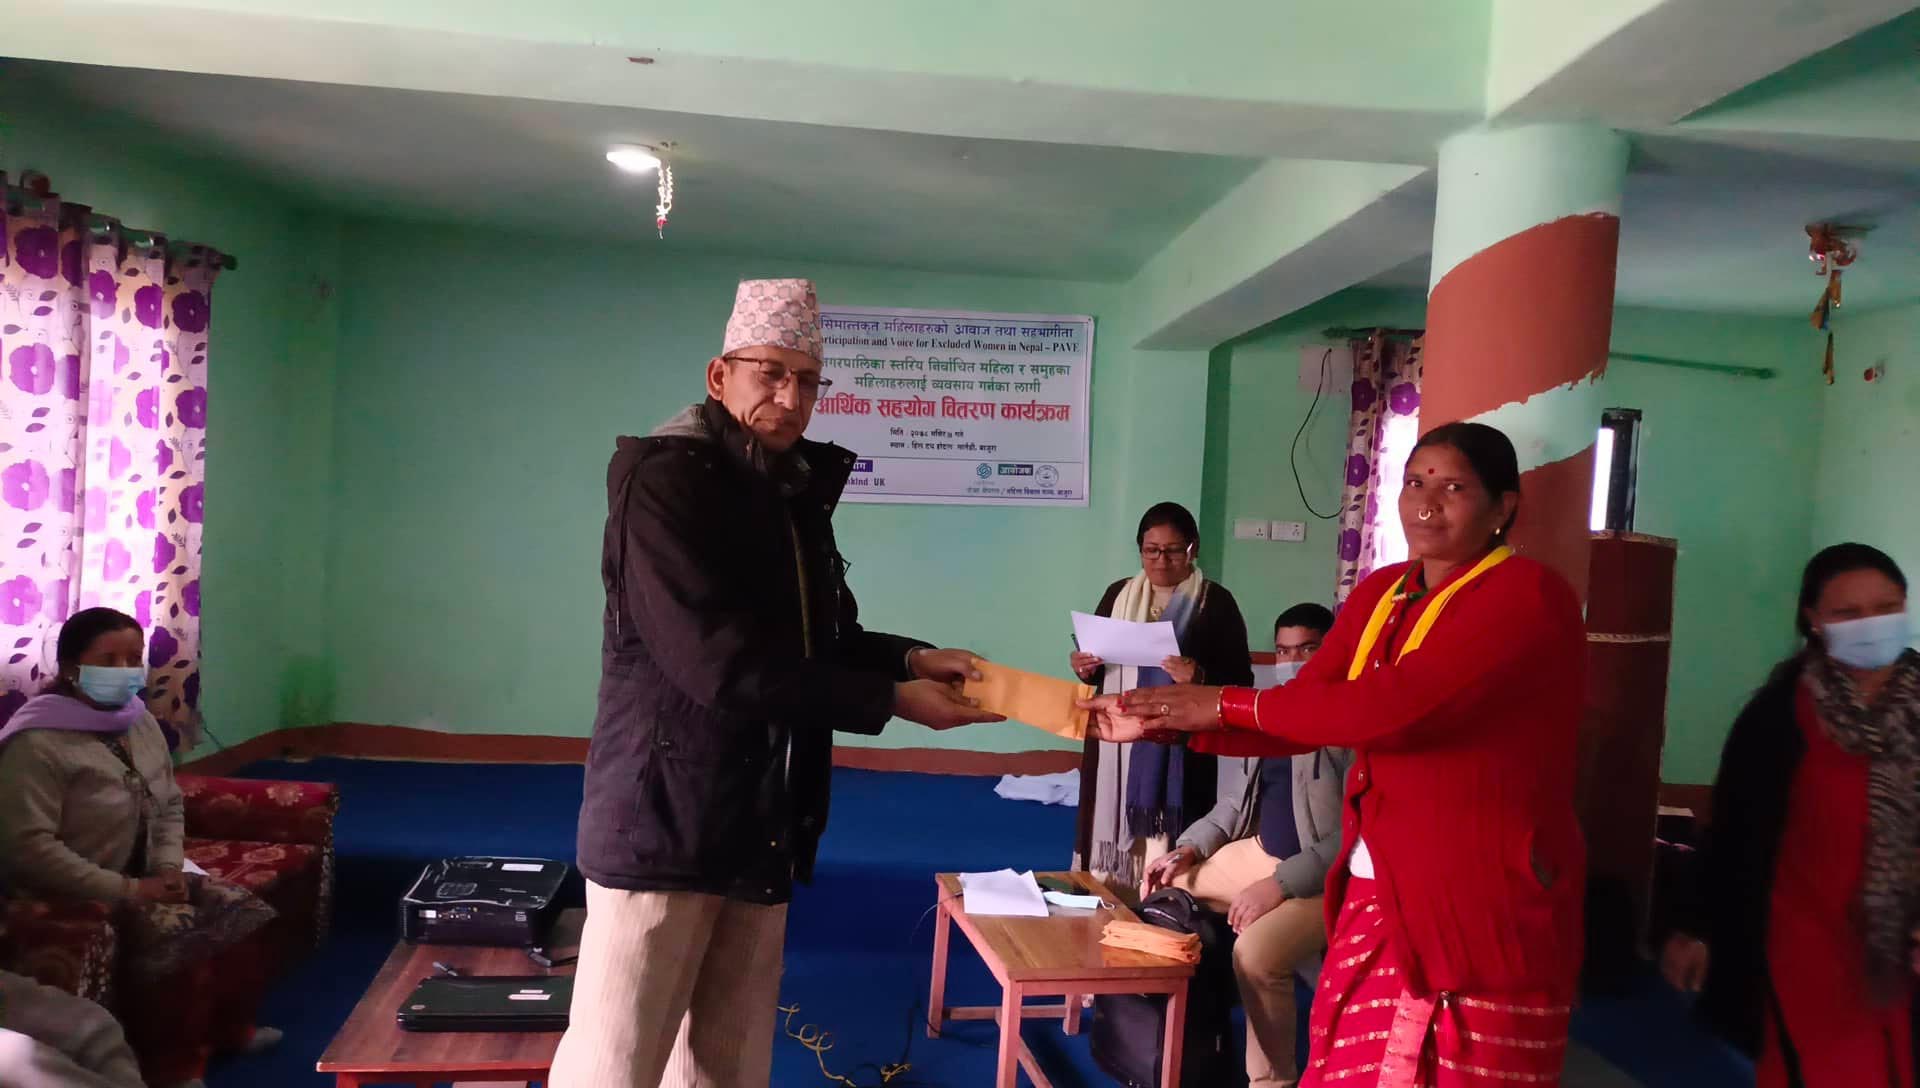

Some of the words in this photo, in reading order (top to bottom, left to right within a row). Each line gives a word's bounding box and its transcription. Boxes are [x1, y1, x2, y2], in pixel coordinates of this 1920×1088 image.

[954, 324, 990, 336] आवाज
[995, 326, 1016, 337] तथा
[1021, 324, 1074, 339] सहभागीता
[872, 338, 887, 347] and
[890, 338, 914, 349] Voice
[916, 338, 928, 348] for
[931, 338, 970, 350] Excluded
[973, 340, 1006, 352] Women
[1008, 341, 1017, 351] in
[1019, 341, 1043, 354] Nepal
[1053, 343, 1080, 353] PAVE
[889, 356, 924, 371] स्तरिय
[979, 359, 1014, 374] महिला
[1018, 365, 1026, 376] र
[1030, 365, 1071, 379] समुहका
[854, 373, 927, 392] महिलाहरुलाई
[931, 379, 974, 391] व्यवसाय
[1014, 379, 1042, 393] लागी
[815, 393, 871, 416] आर्थिक
[877, 395, 936, 418] सहयोग
[941, 395, 996, 420] वितरण
[1001, 399, 1071, 422] कार्यक्रम
[873, 478, 886, 487] UK
